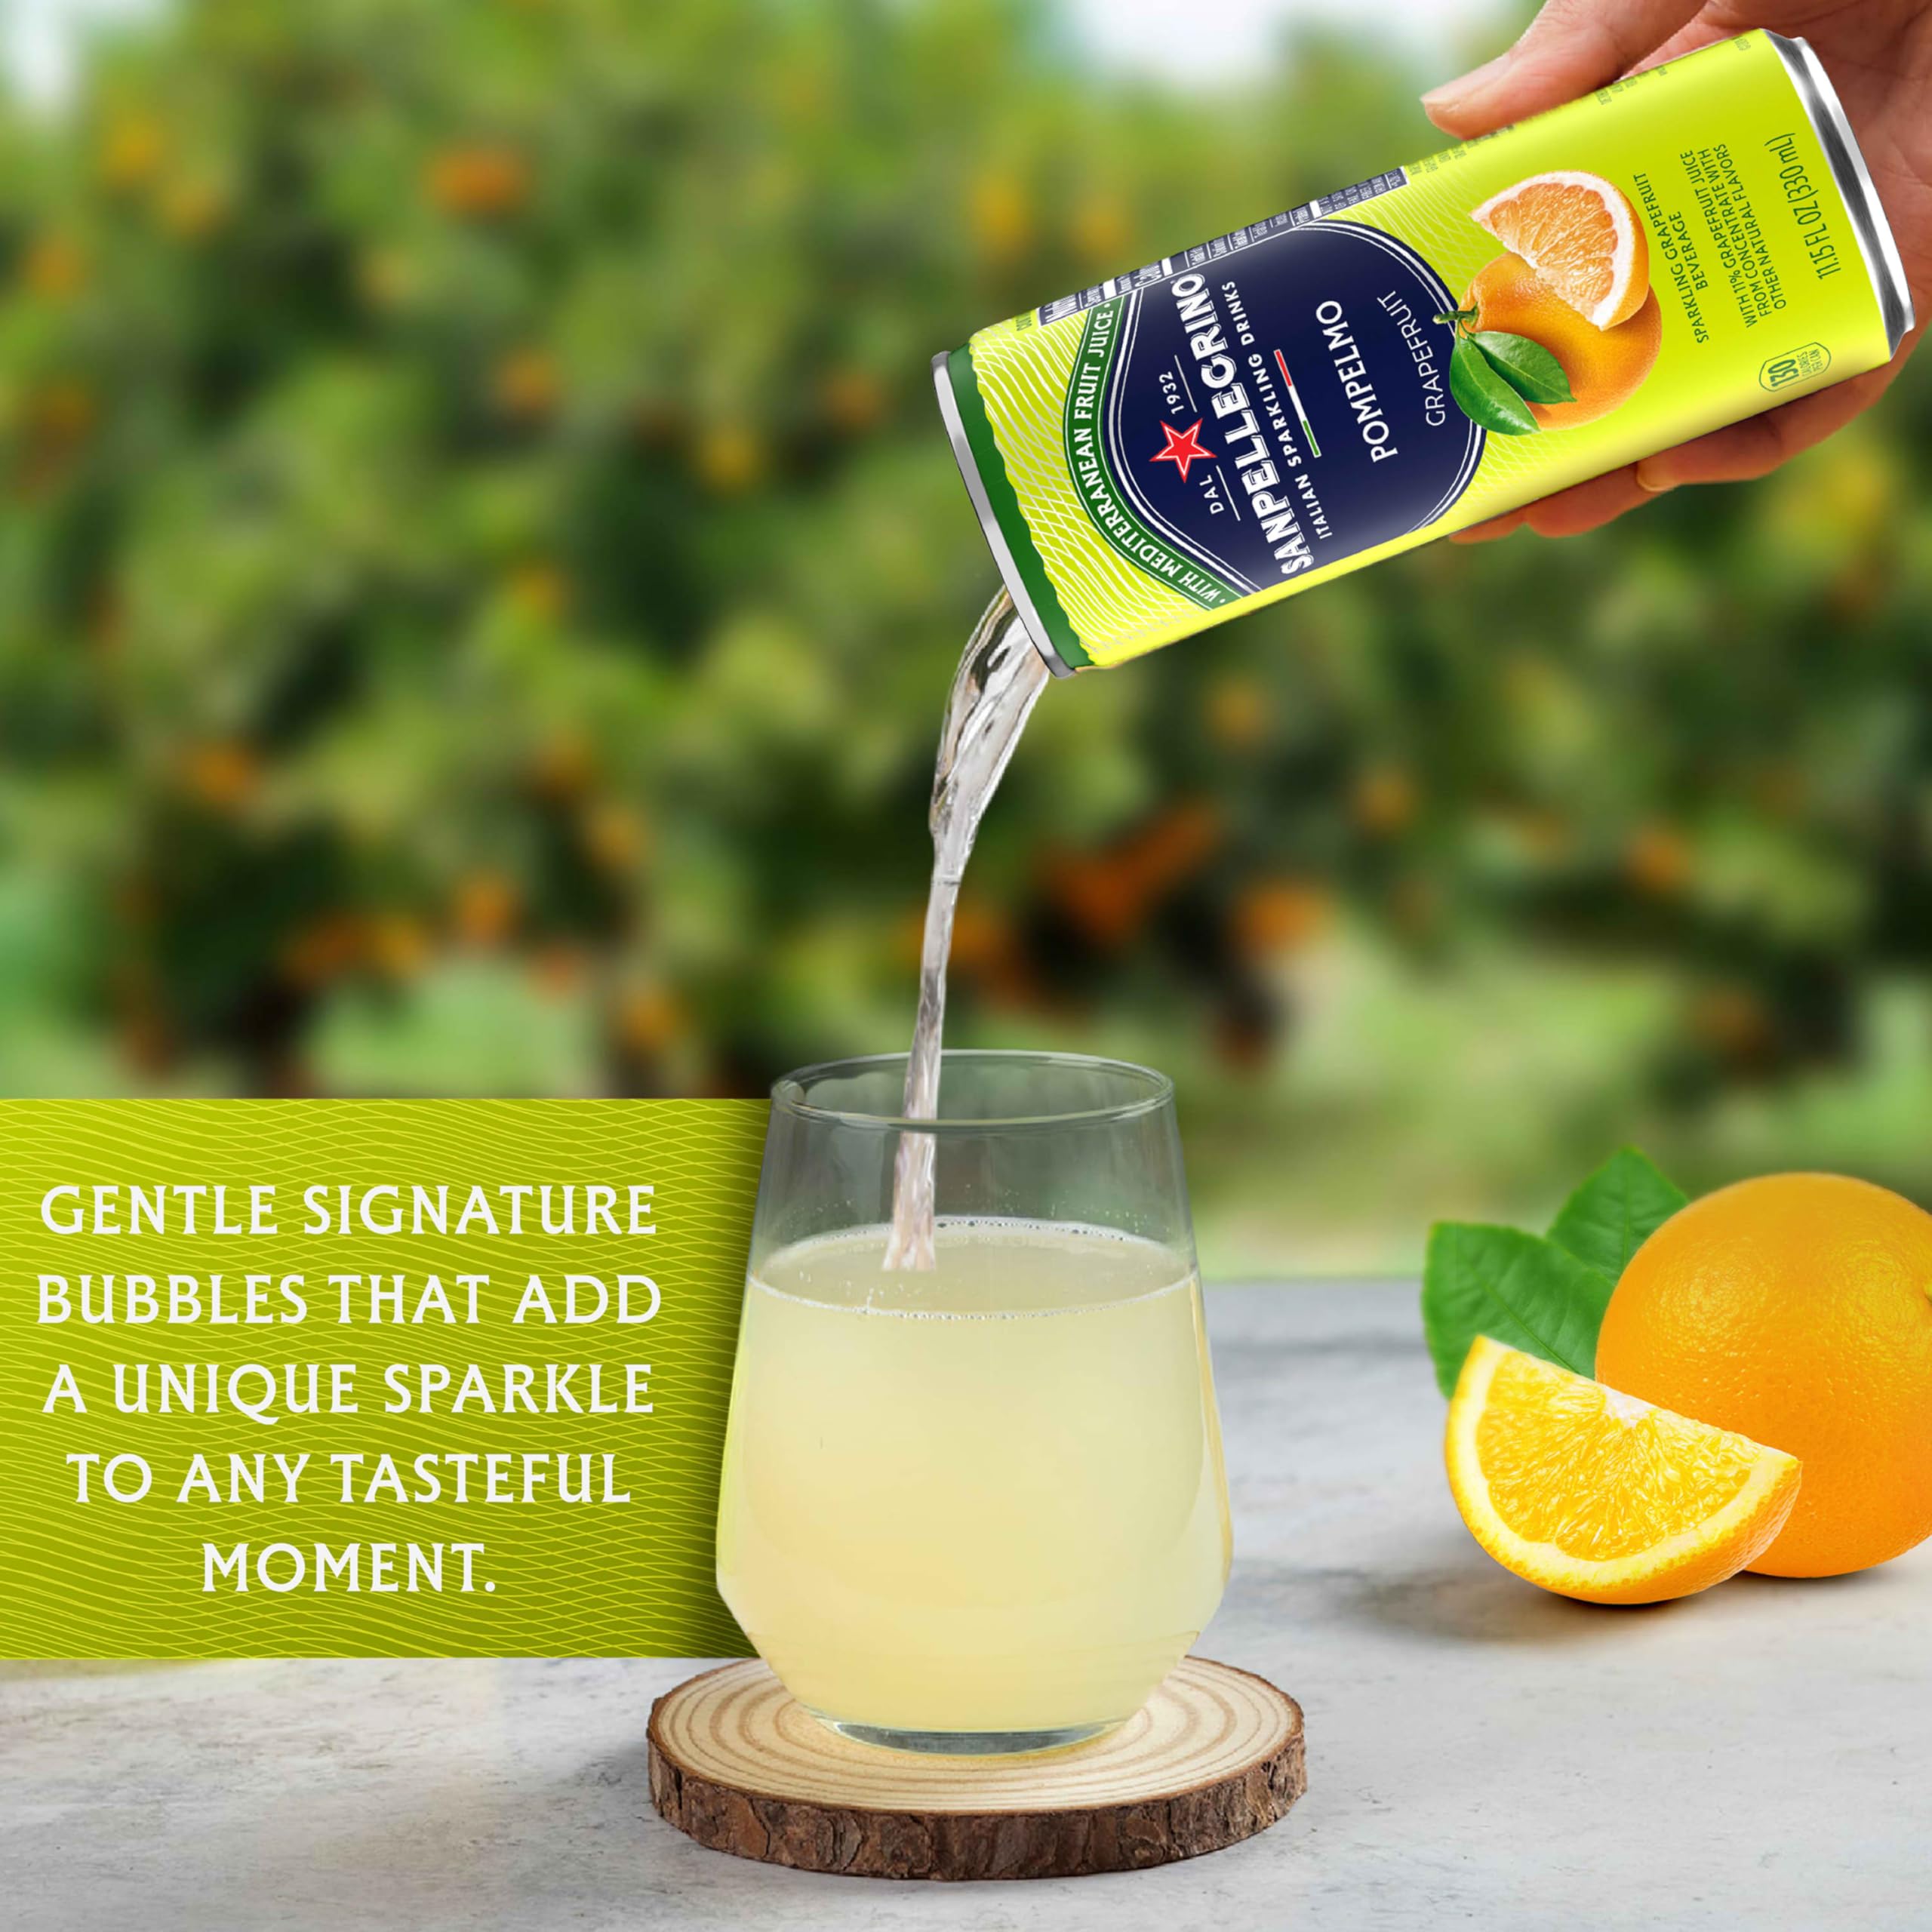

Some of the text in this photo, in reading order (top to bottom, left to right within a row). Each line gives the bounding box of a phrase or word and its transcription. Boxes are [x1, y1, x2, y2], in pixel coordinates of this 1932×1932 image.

[1633, 173, 1709, 343] SPARKLING GRAPEFRUIT
[1669, 211, 1709, 290] BEVERAGE
[1680, 150, 1758, 328] WITH 11% GRAPEFRUIT JUICE
[1697, 148, 1772, 317] FROM CONCENTRATE WITH
[1714, 143, 1787, 309] OTHER NATURAL FLAVORS
[1764, 132, 1841, 280] 11.15 FL OZ (330 mL)
[1222, 281, 1255, 346] DRINKS
[1315, 300, 1398, 462] POMPELMO
[1377, 290, 1446, 426] GRAPEFRUIT
[1767, 359, 1799, 386] 130
[1074, 309, 1218, 602] WITH MEDITERRANEAN FRUIT JUICE
[1159, 371, 1225, 515] DAL 1932
[1171, 273, 1314, 574] SANPELLEGRINO
[1248, 353, 1302, 466] SPARKLING
[1294, 474, 1333, 539] ITALIAN
